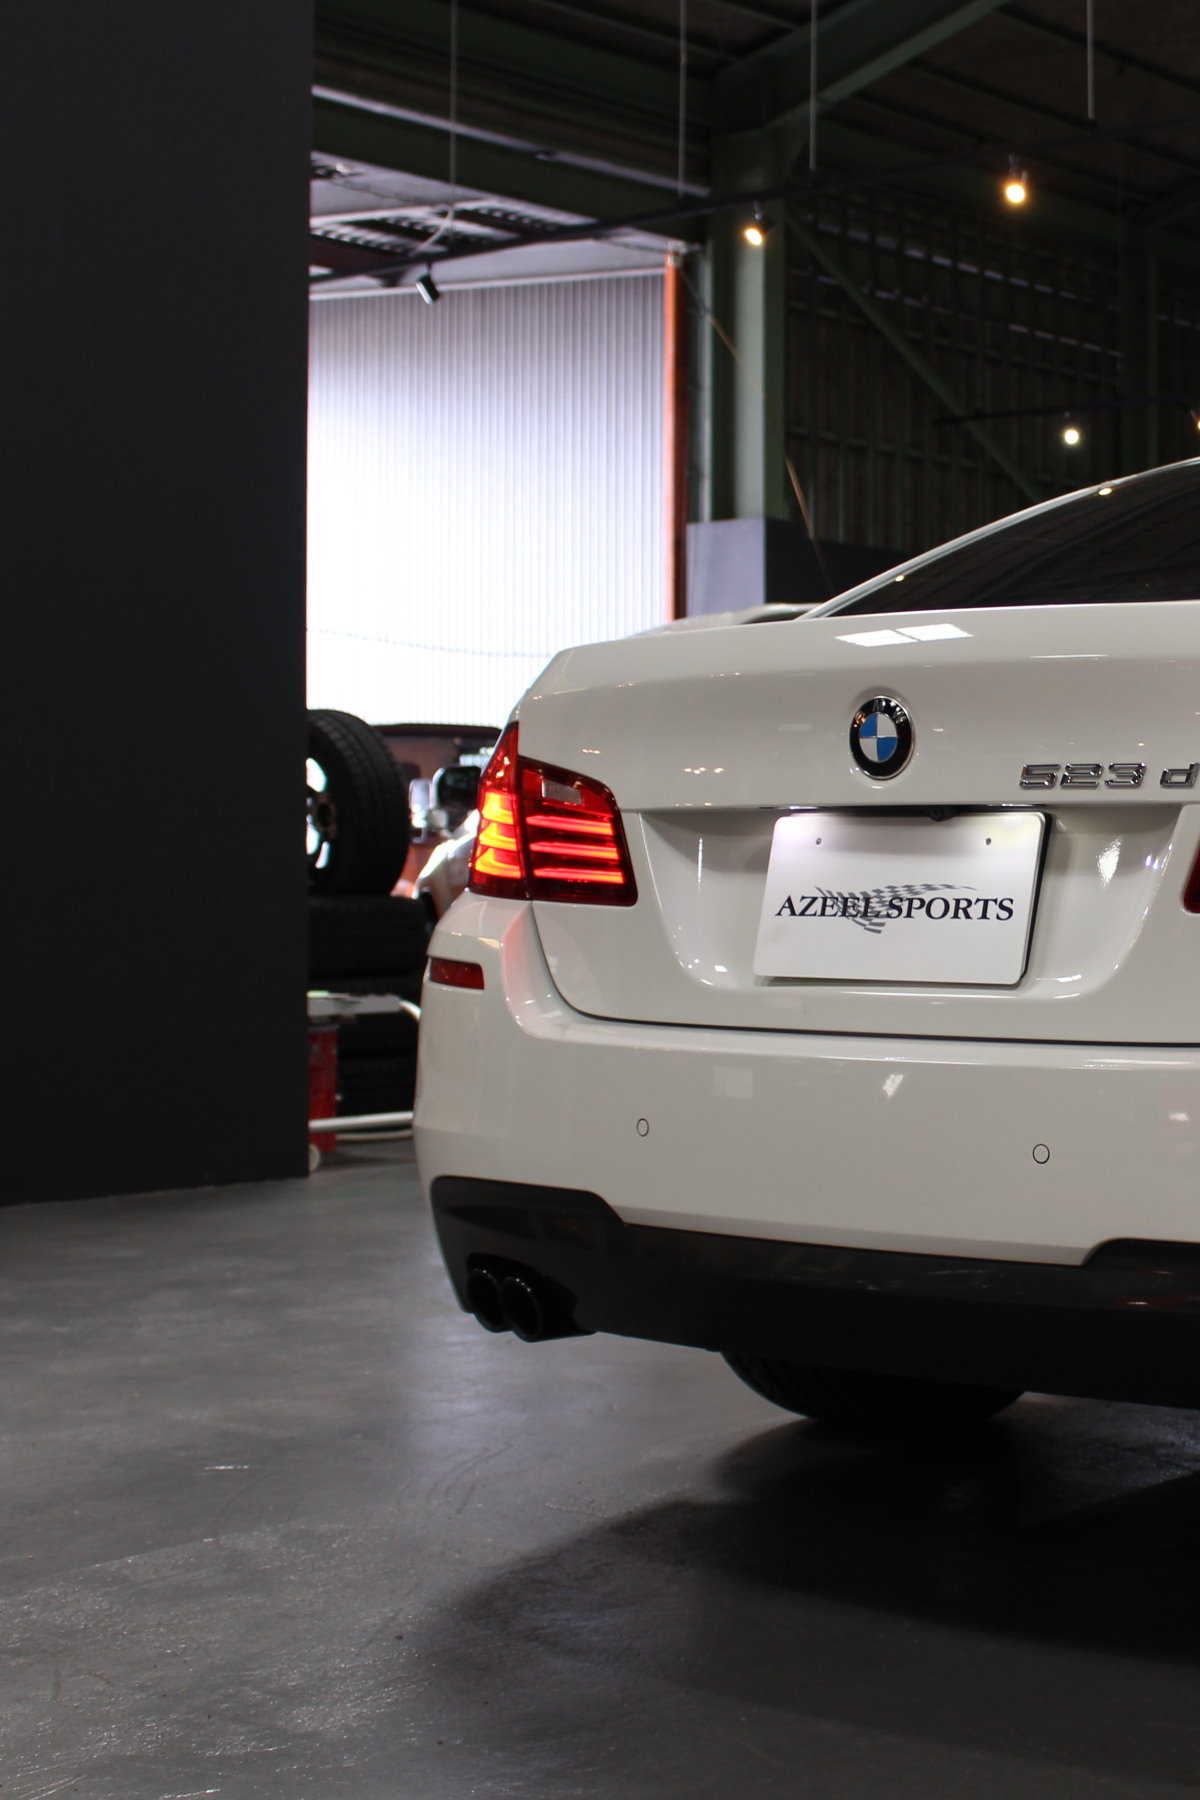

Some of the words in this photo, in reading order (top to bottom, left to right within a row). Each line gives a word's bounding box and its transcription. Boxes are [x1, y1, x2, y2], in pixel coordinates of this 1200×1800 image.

[1160, 762, 1200, 787] d
[775, 895, 881, 918] AZEEL
[886, 896, 1015, 921] SPORTS
